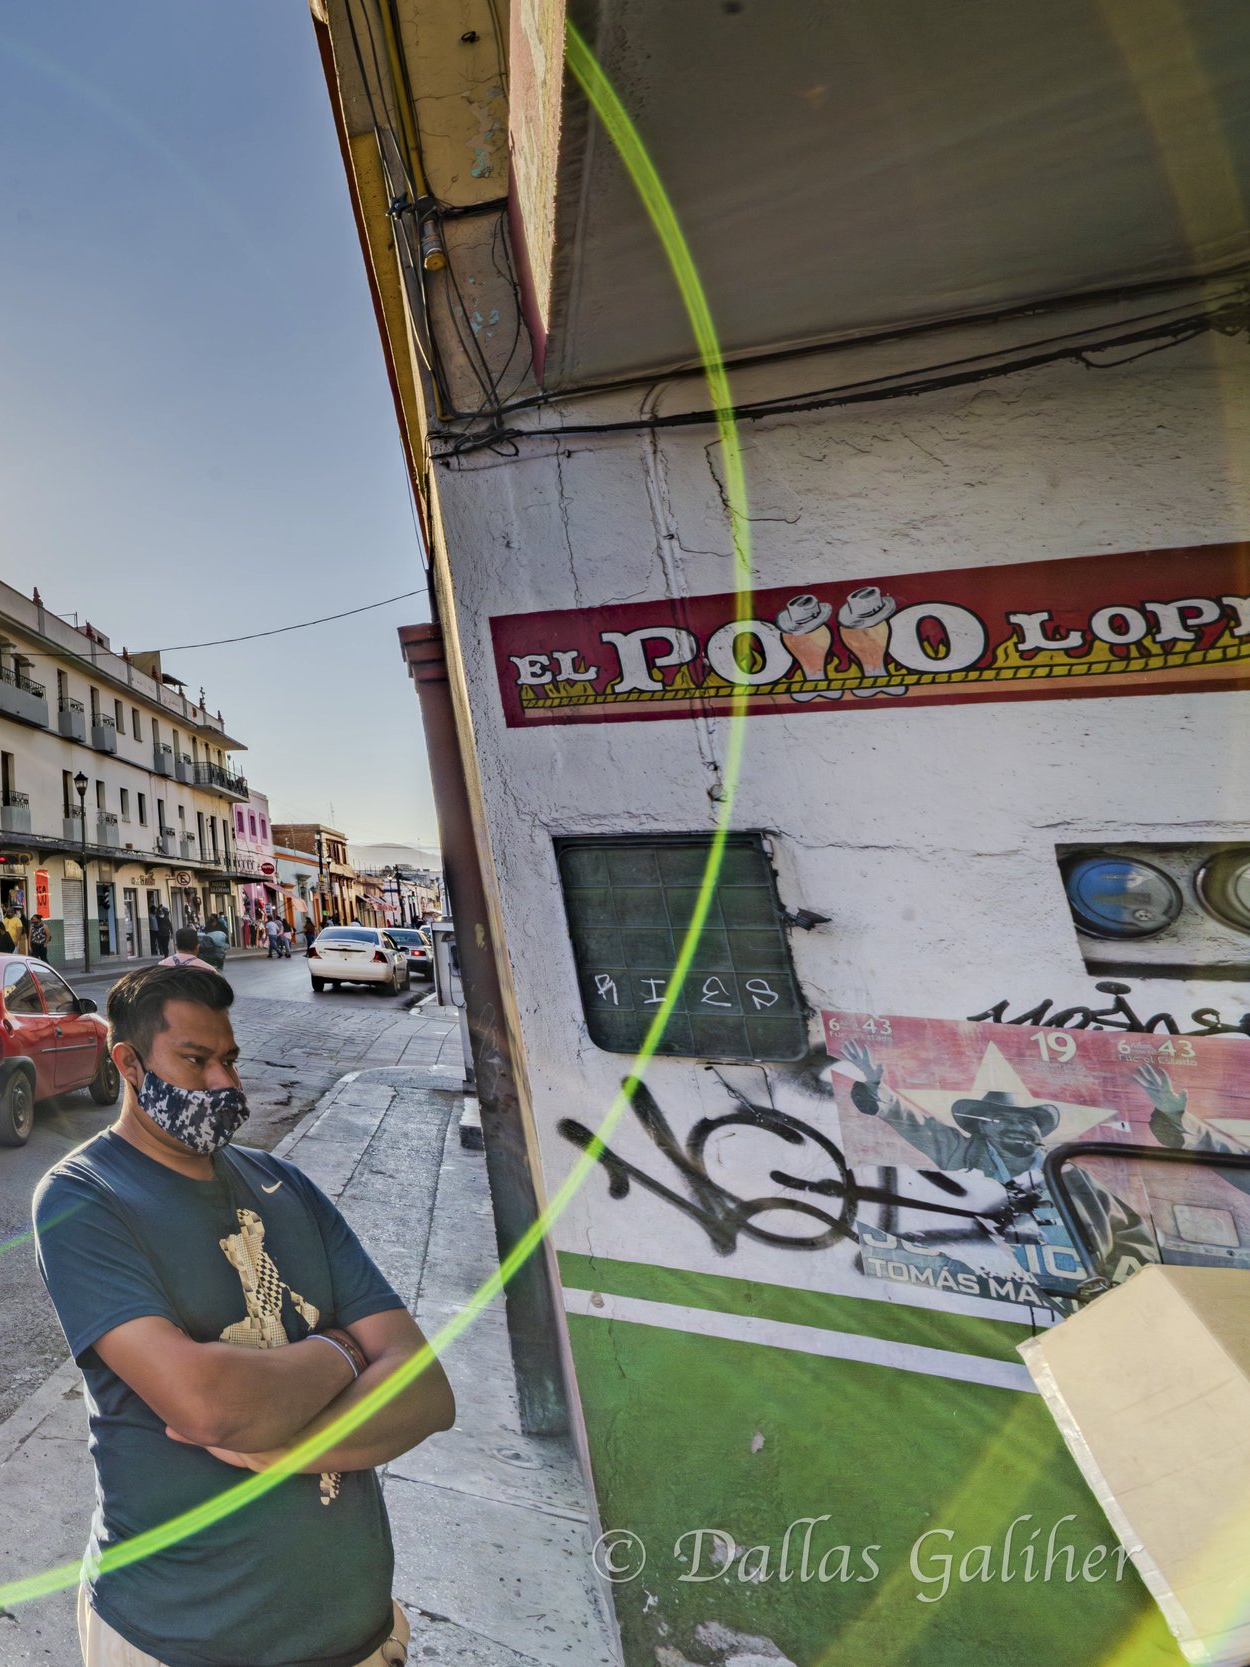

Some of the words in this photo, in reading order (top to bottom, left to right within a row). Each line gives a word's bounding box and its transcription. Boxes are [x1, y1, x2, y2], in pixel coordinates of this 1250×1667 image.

[510, 650, 600, 686] EL
[861, 1018, 893, 1035] 43
[1030, 1030, 1077, 1063] 19
[1117, 1040, 1131, 1054] 6
[1158, 1039, 1196, 1058] 43
[867, 1257, 980, 1295] TOMÁS
